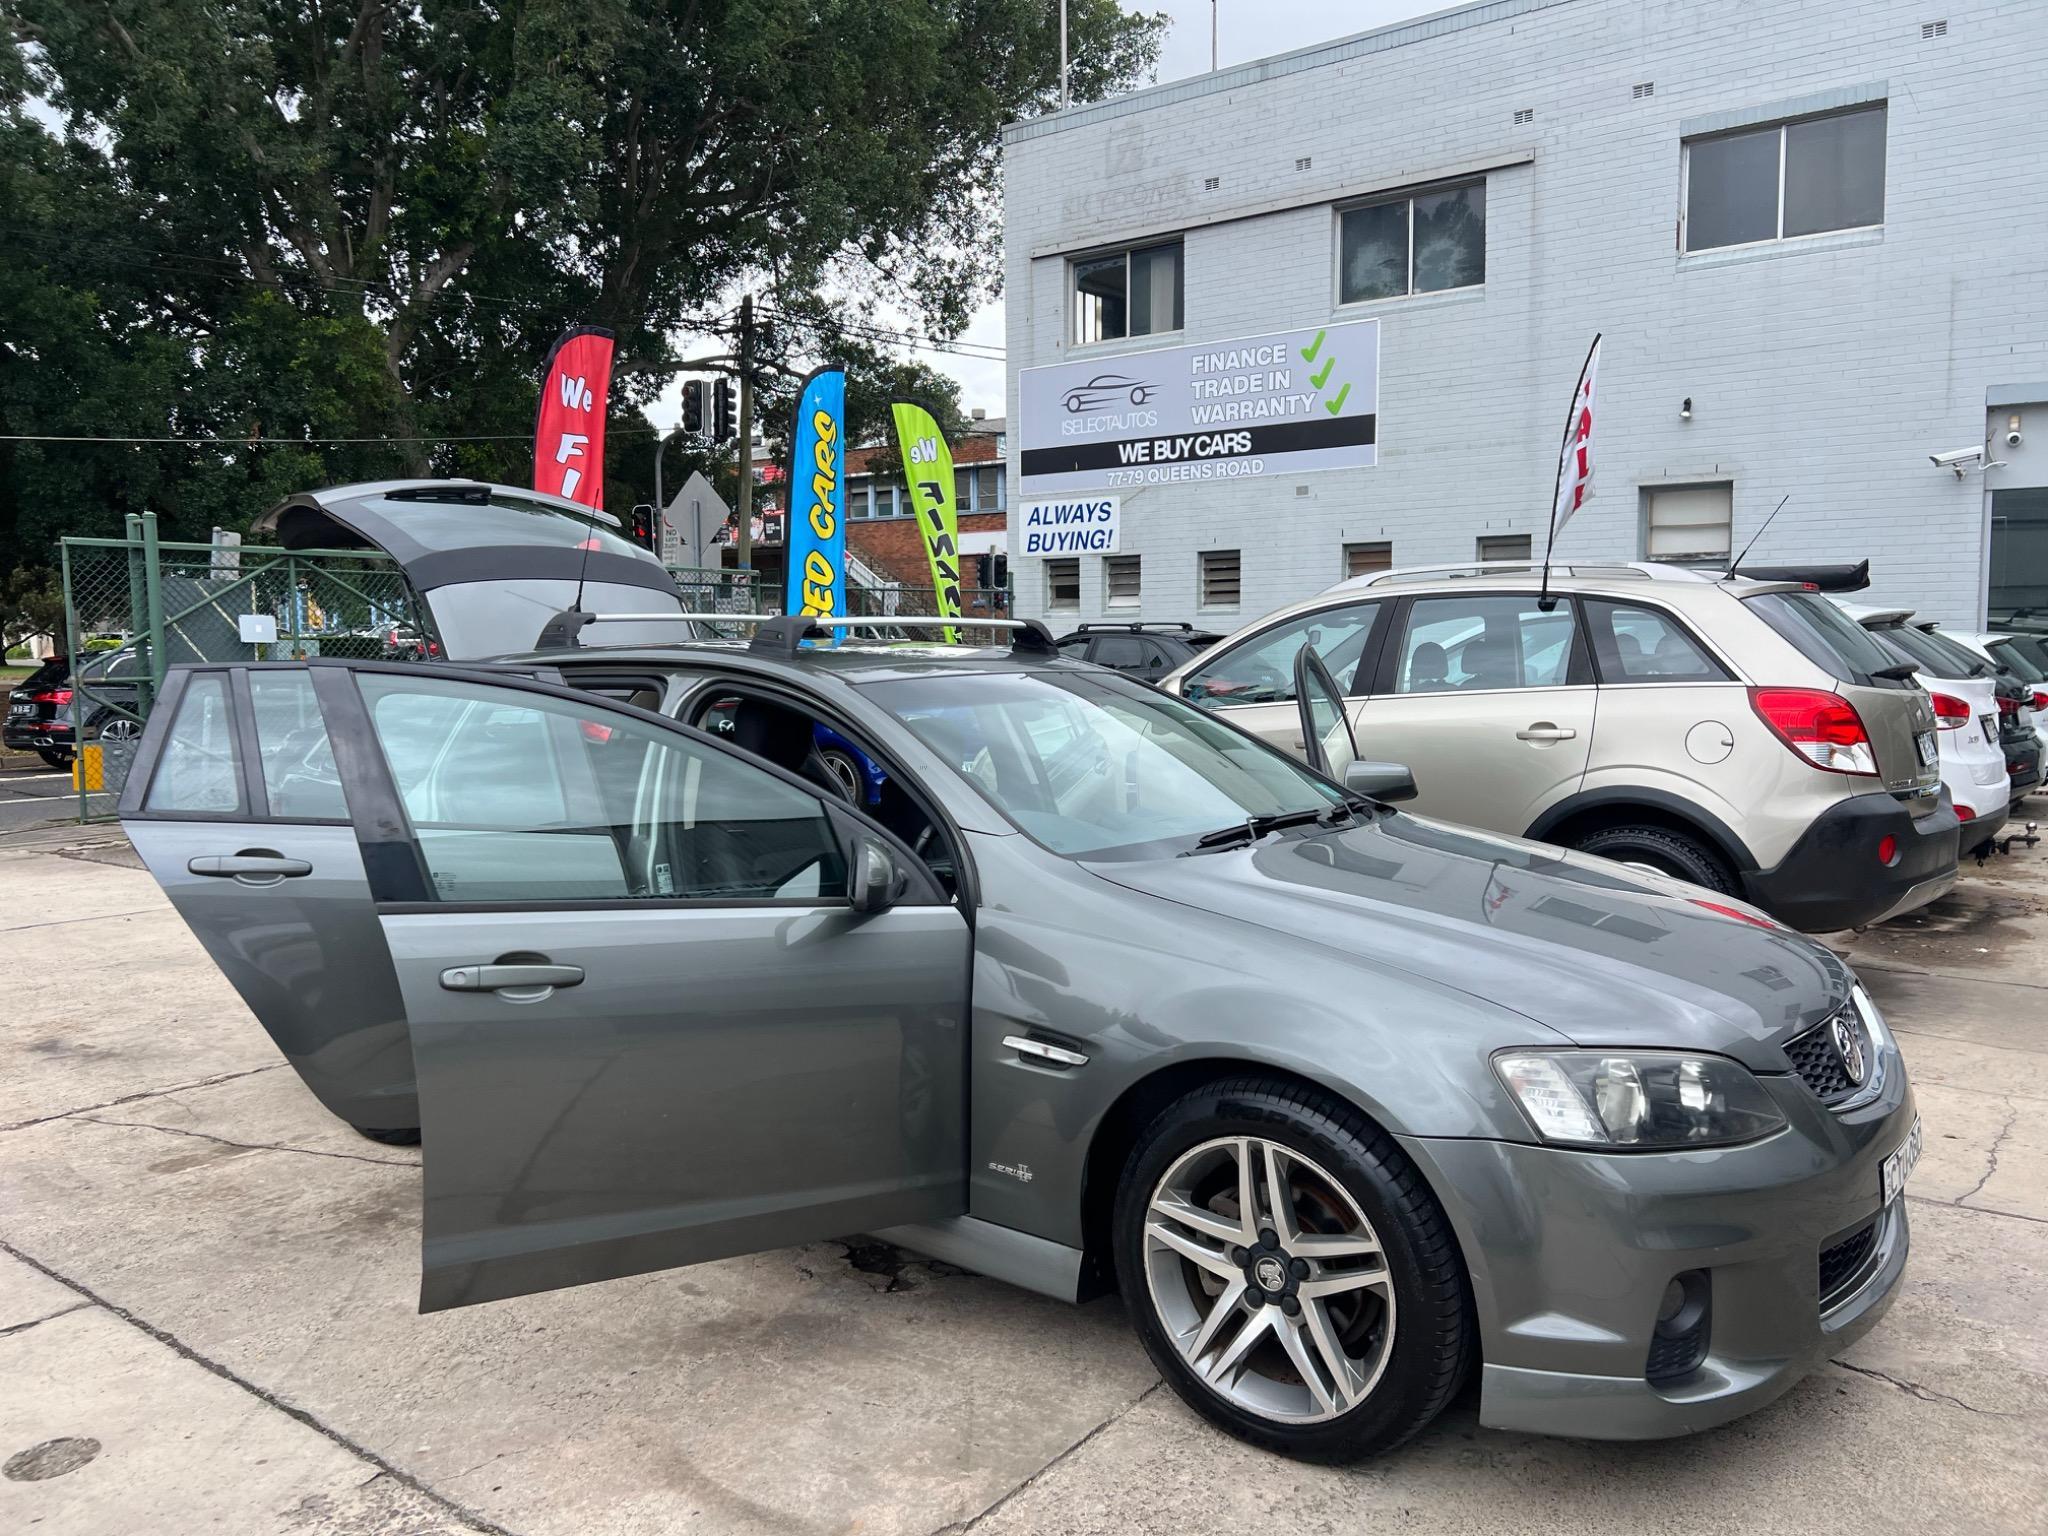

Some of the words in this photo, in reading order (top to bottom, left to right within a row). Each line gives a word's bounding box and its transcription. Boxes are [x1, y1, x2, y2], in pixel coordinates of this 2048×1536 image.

[1191, 343, 1287, 375] FINANCE
[560, 371, 593, 413] We
[1191, 372, 1264, 400] TRADE
[1268, 369, 1291, 391] IN
[1062, 410, 1158, 437] ISELECTAUTOS
[1191, 392, 1318, 425] WARRANTY
[1118, 440, 1149, 465] WE
[1154, 437, 1195, 461] BUY
[1195, 431, 1252, 458] CARS
[808, 409, 837, 541] CARS
[1107, 470, 1145, 487] 77-79
[1147, 462, 1212, 483] QUEENS
[1216, 458, 1264, 478] ROAD
[1027, 501, 1112, 526] ALWAYS
[1027, 529, 1113, 553] BUYING!
